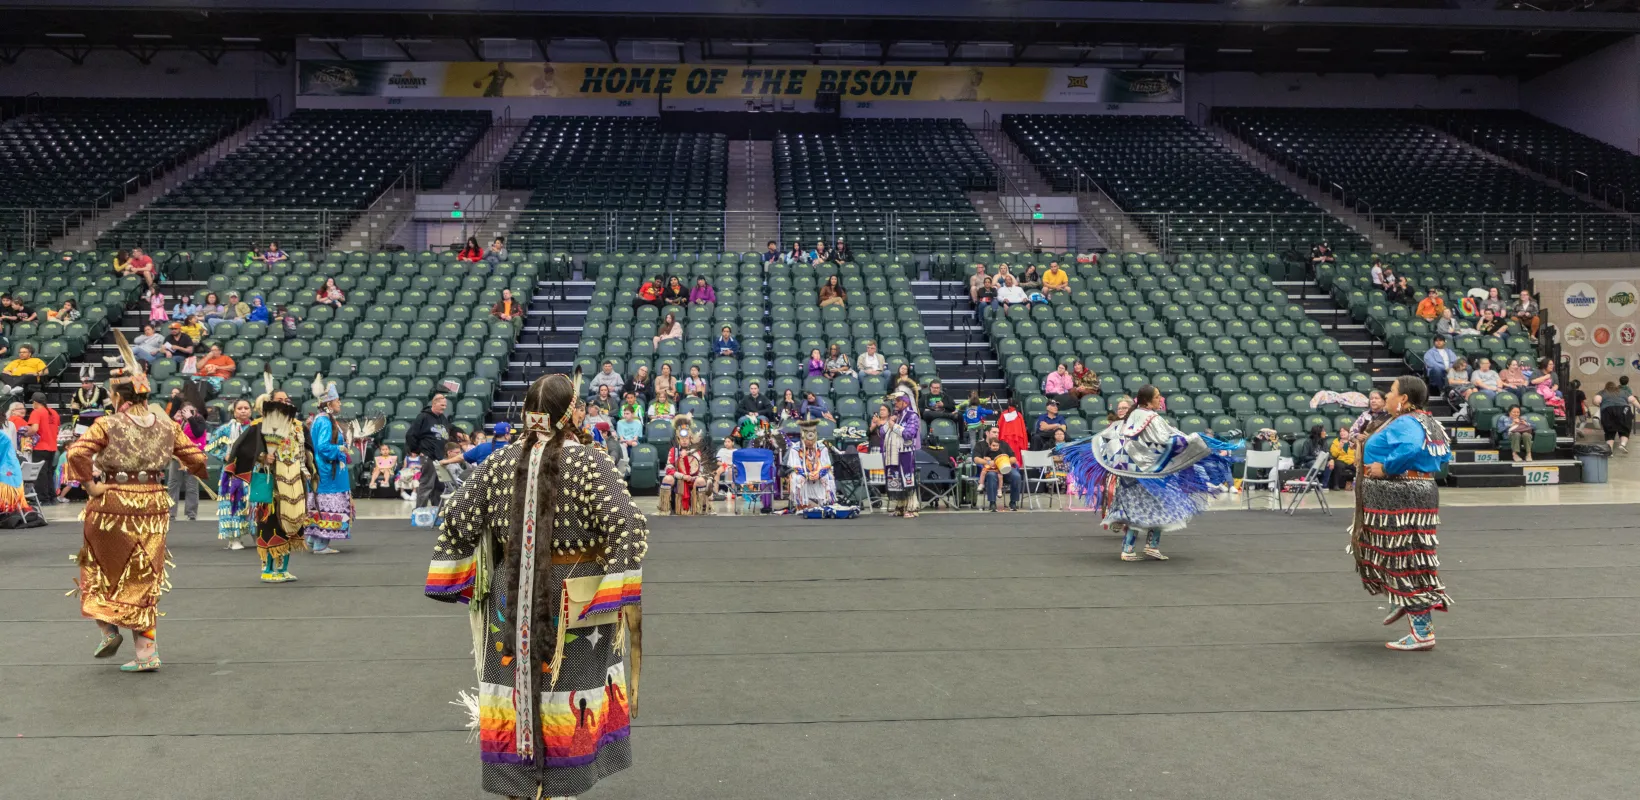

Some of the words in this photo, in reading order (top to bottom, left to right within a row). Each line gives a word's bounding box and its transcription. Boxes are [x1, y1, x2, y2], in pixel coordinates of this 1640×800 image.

[388, 77, 427, 85] SUMMIT
[579, 67, 677, 94] HOME
[686, 67, 729, 94] OF
[741, 69, 808, 95] THE
[816, 69, 918, 96] BISON
[1579, 356, 1599, 366] DENVER
[1527, 471, 1550, 483] 105
